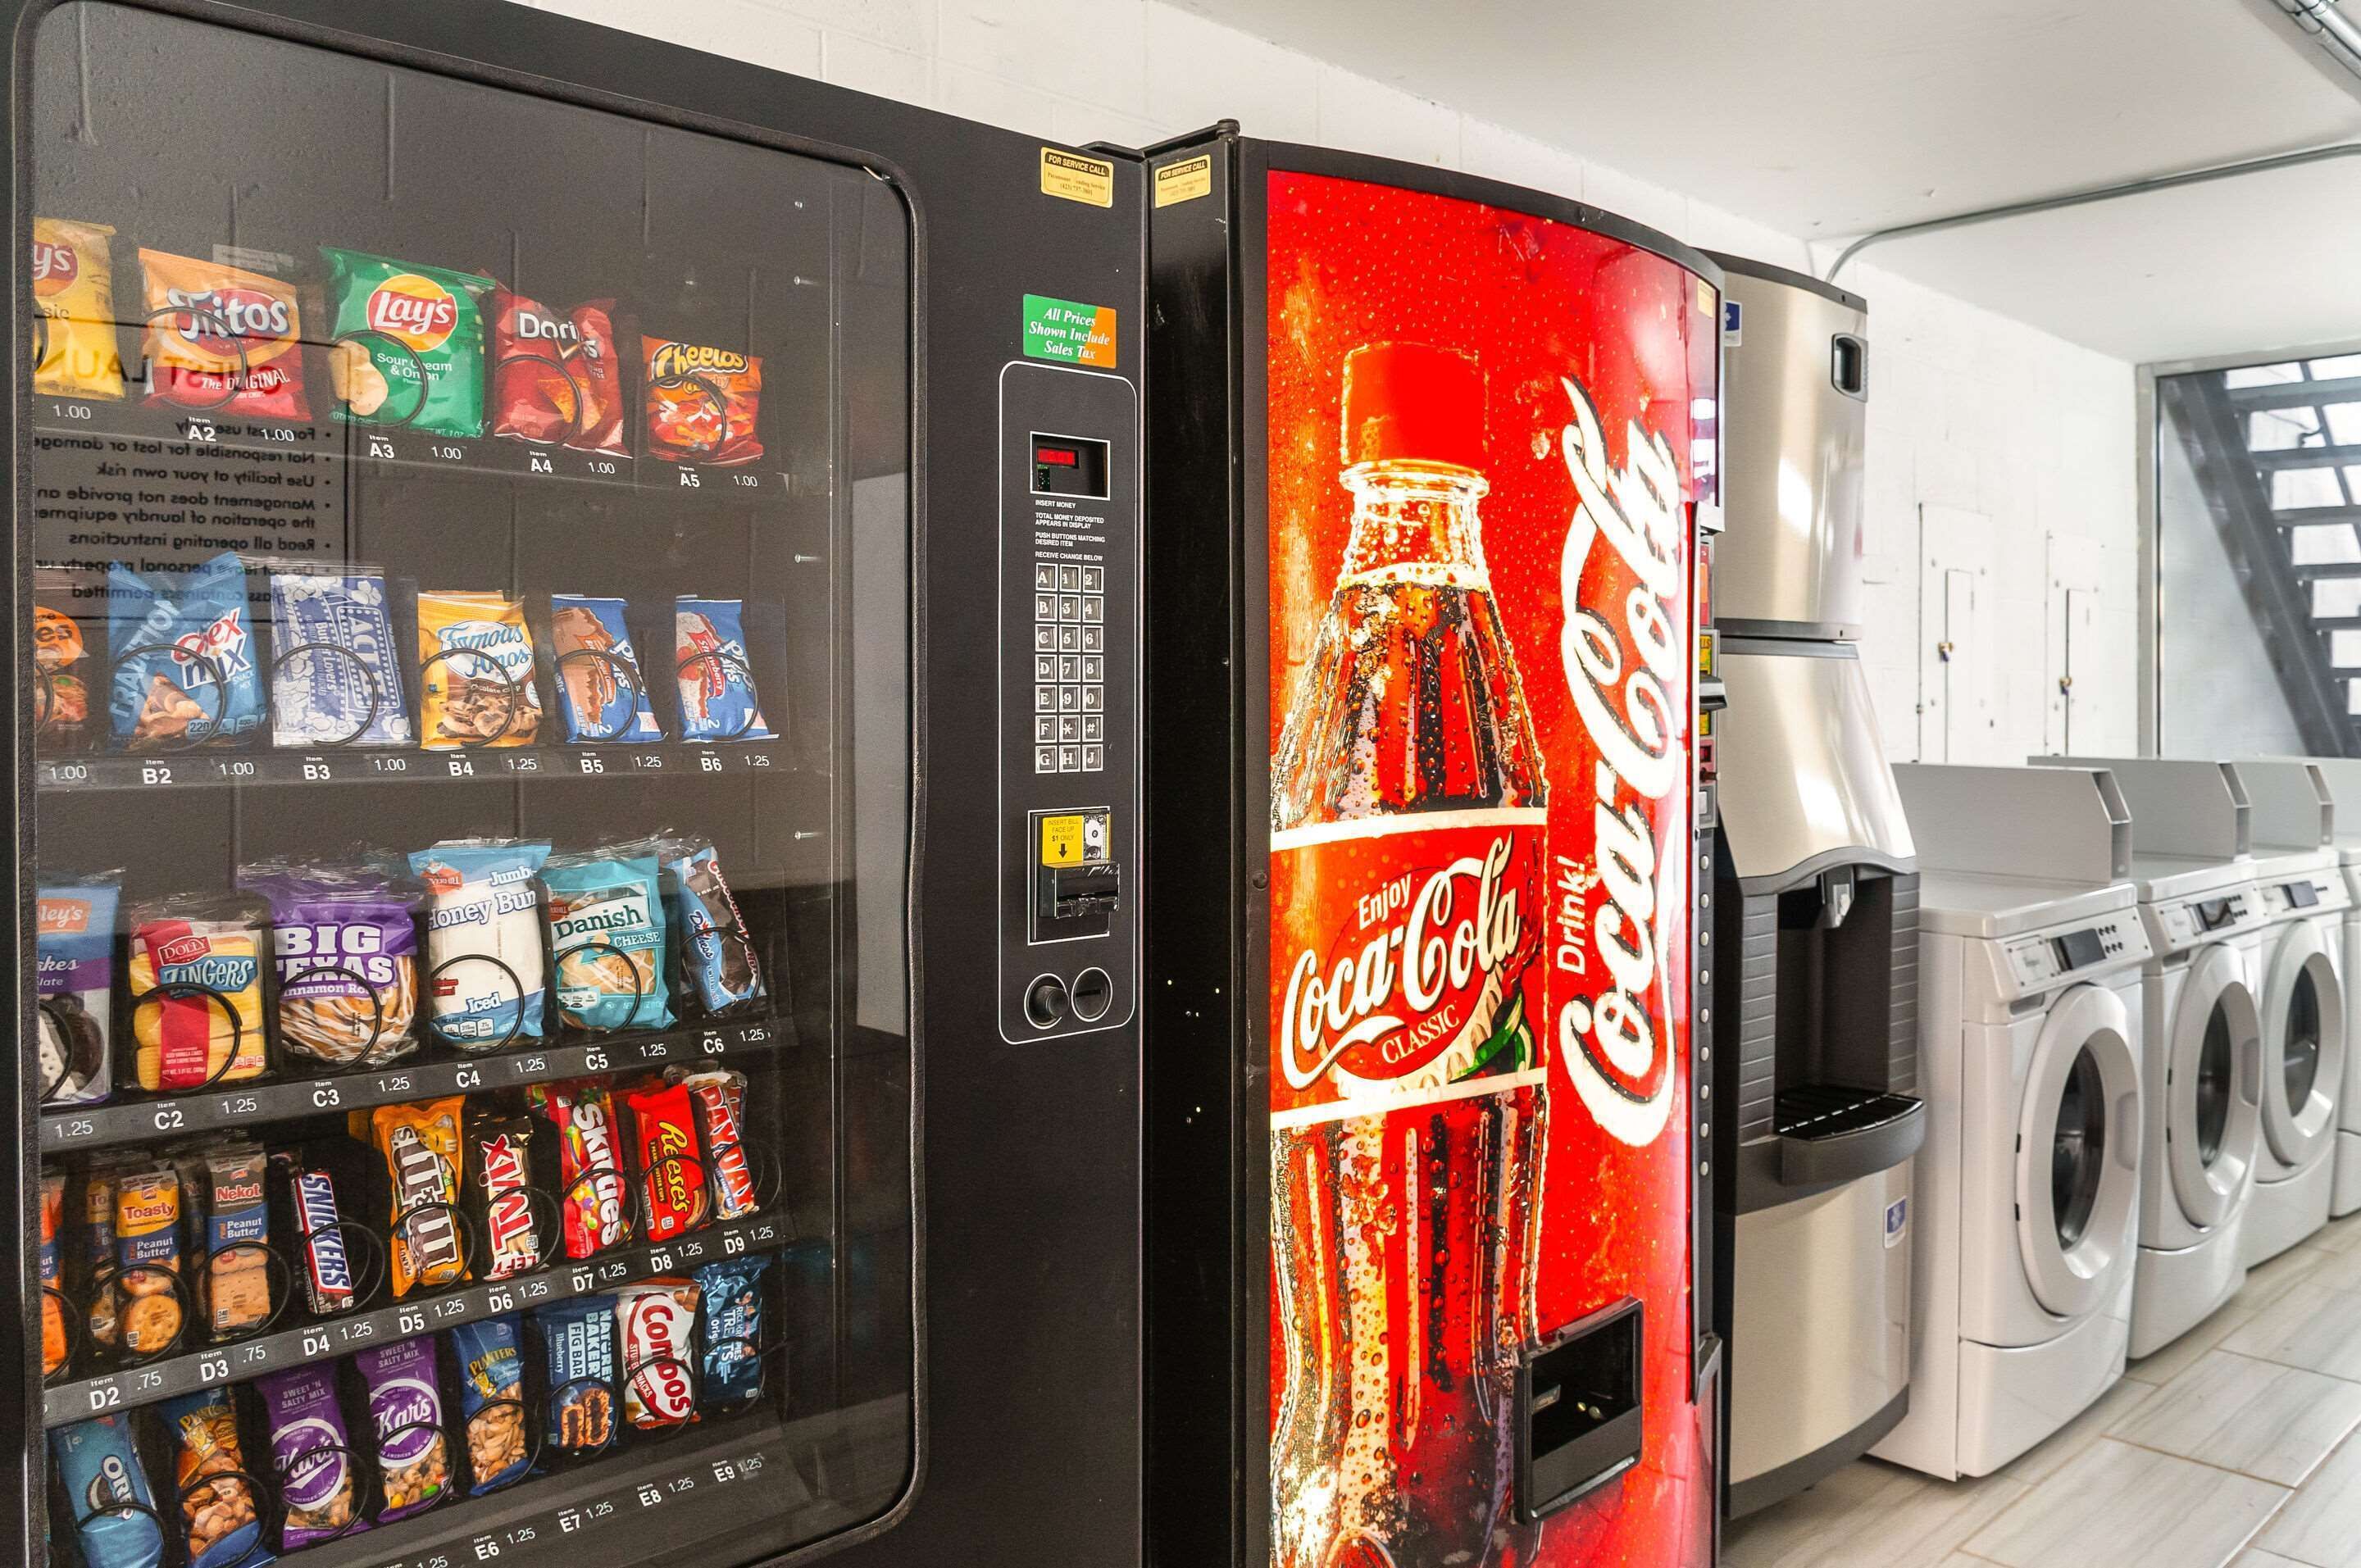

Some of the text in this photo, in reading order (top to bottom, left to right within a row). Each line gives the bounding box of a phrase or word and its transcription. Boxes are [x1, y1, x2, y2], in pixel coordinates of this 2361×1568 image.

[1049, 154, 1106, 175] FOR SERVICE CALL
[1193, 161, 1206, 170] CALL
[374, 291, 453, 335] Lay's
[1044, 308, 1096, 327] All Prices
[1029, 320, 1110, 345] Shown Include
[1044, 340, 1096, 359] Sales Tax
[377, 353, 407, 366] Sour
[53, 405, 91, 420] 1.00
[188, 425, 216, 442] A2
[262, 429, 295, 442] 1.00
[370, 443, 394, 459] A3
[431, 446, 462, 459] 1.00
[530, 458, 553, 473] A4
[589, 462, 615, 474] 1.00
[680, 473, 700, 488] A5
[734, 475, 758, 488] 1.00
[1075, 516, 1104, 524] DEPOSITED
[1078, 534, 1105, 543] MATCHING
[1035, 551, 1059, 559] RECEIVE
[1060, 552, 1083, 561] CHANGE
[219, 761, 254, 775] 1.00
[375, 759, 407, 772] 1.00
[448, 761, 474, 776] B4
[507, 759, 537, 770] 1.25
[580, 758, 604, 774] B5
[635, 756, 662, 767] 1.25
[700, 757, 722, 772] B6
[744, 755, 770, 767] 1.25
[1559, 375, 1681, 1147] Coca-Cola
[49, 766, 87, 779] 1.00
[143, 768, 172, 784] B2
[303, 764, 330, 779] B3
[1052, 834, 1059, 842] $1
[1358, 872, 1412, 931] Enjoy
[554, 905, 644, 939] Danish
[1557, 855, 1585, 975] Drink!
[273, 925, 380, 955] BIG
[614, 932, 661, 948] CHEESE
[164, 940, 206, 958] DOLLY
[1281, 830, 1520, 1090] Coca-Cola
[466, 993, 502, 1014] Iced
[739, 1029, 765, 1043] 1.25
[1381, 1004, 1461, 1064] CLASSIC
[640, 1043, 666, 1057] 1.25
[703, 1039, 725, 1054] C6
[516, 1058, 545, 1074] 1.25
[585, 1054, 608, 1070] C5
[378, 1077, 410, 1093] 1.25
[456, 1070, 481, 1089] C4
[222, 1098, 257, 1114] 1.25
[313, 1089, 340, 1108] C3
[154, 1110, 184, 1130] C2
[55, 1120, 93, 1139] 1.25
[659, 1121, 691, 1213] Reese's
[216, 1184, 261, 1202] Nekot
[125, 1202, 176, 1220] Toasty
[227, 1216, 262, 1229] Peanut
[302, 1173, 351, 1289] SNICKERS
[227, 1227, 259, 1238] Butter
[749, 1225, 774, 1241] 1.25
[137, 1237, 173, 1250] Peanut
[678, 1242, 703, 1257] 1.25
[724, 1237, 745, 1254] D9
[138, 1247, 171, 1261] Butter
[599, 1262, 627, 1279] 1.25
[650, 1254, 673, 1272] D8
[519, 1281, 548, 1299] 1.25
[572, 1273, 594, 1293] D7
[434, 1299, 465, 1317] 1.25
[489, 1294, 514, 1313] D6
[340, 1322, 373, 1340] 1.25
[398, 1314, 425, 1334] D5
[243, 1345, 266, 1363] .75
[303, 1335, 330, 1357] D4
[380, 1346, 405, 1357] SWEET
[554, 1332, 564, 1374] Blueberry
[571, 1325, 585, 1375] FIG BAR
[379, 1349, 420, 1368] SALTY MIX
[469, 1346, 517, 1375] PLANTERS
[199, 1360, 230, 1382] D3
[137, 1370, 162, 1390] .75
[89, 1386, 121, 1410] D2
[282, 1388, 325, 1408] SALTY MIX
[283, 1386, 310, 1399] SWEET
[738, 1457, 762, 1472] 1.25
[712, 1466, 735, 1483] E9
[667, 1477, 694, 1494] 1.25
[639, 1489, 662, 1507] E8
[585, 1501, 614, 1519] 1.25
[559, 1514, 581, 1533] E7
[506, 1527, 536, 1545] 1.25
[475, 1541, 500, 1561] E6
